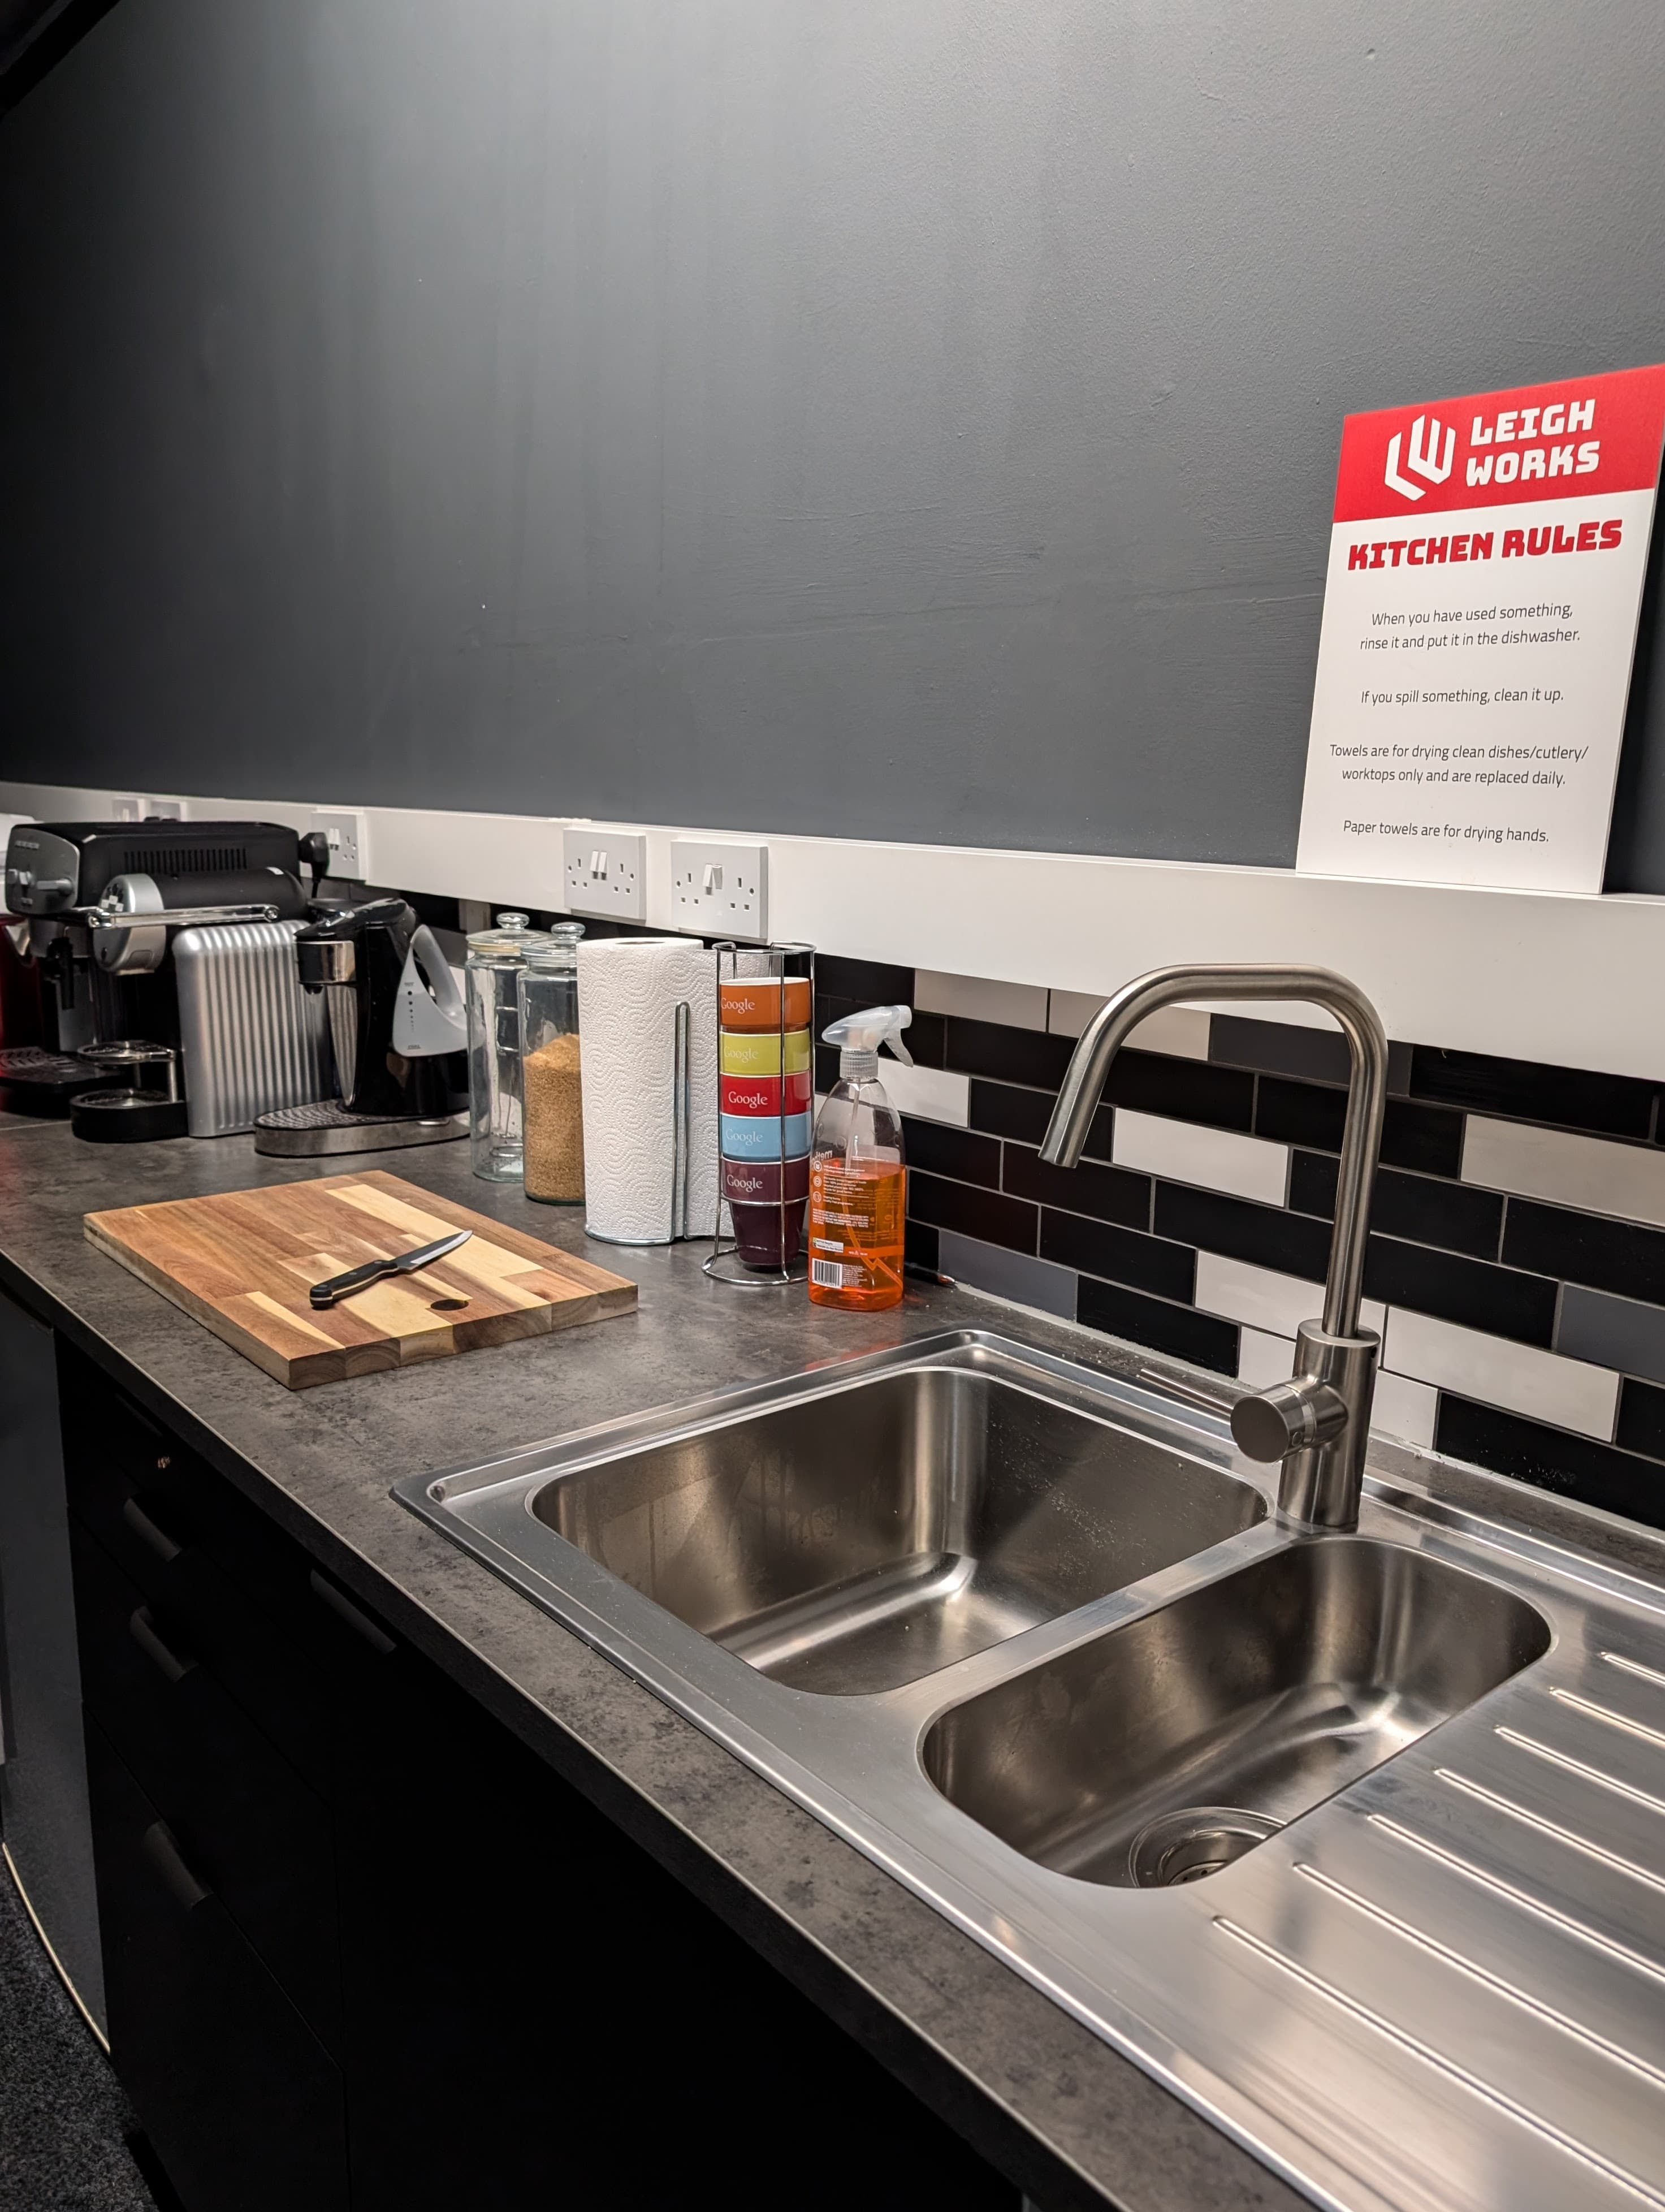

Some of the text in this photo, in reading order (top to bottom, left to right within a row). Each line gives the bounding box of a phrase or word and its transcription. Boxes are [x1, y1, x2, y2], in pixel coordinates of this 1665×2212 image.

[1470, 399, 1595, 446] LEIGH
[1466, 440, 1600, 487] WORKS
[1348, 519, 1622, 571] KITCHEN RULES
[1372, 602, 1573, 628] When you have used something,
[1360, 627, 1580, 651] rinse it and put it in the dishwasher.
[1361, 687, 1564, 707] If you spill something, clean it up.
[1329, 744, 1589, 763] Towels are for drying clean dishes/cutlery/
[1342, 767, 1565, 789] worktops only and are replaced daily.
[1343, 819, 1549, 844] Paper towels are for drying hands.
[721, 997, 755, 1014] Google
[724, 1045, 758, 1062] Google
[728, 1091, 768, 1109] Google
[725, 1129, 763, 1146] Google
[727, 1174, 763, 1193] Google
